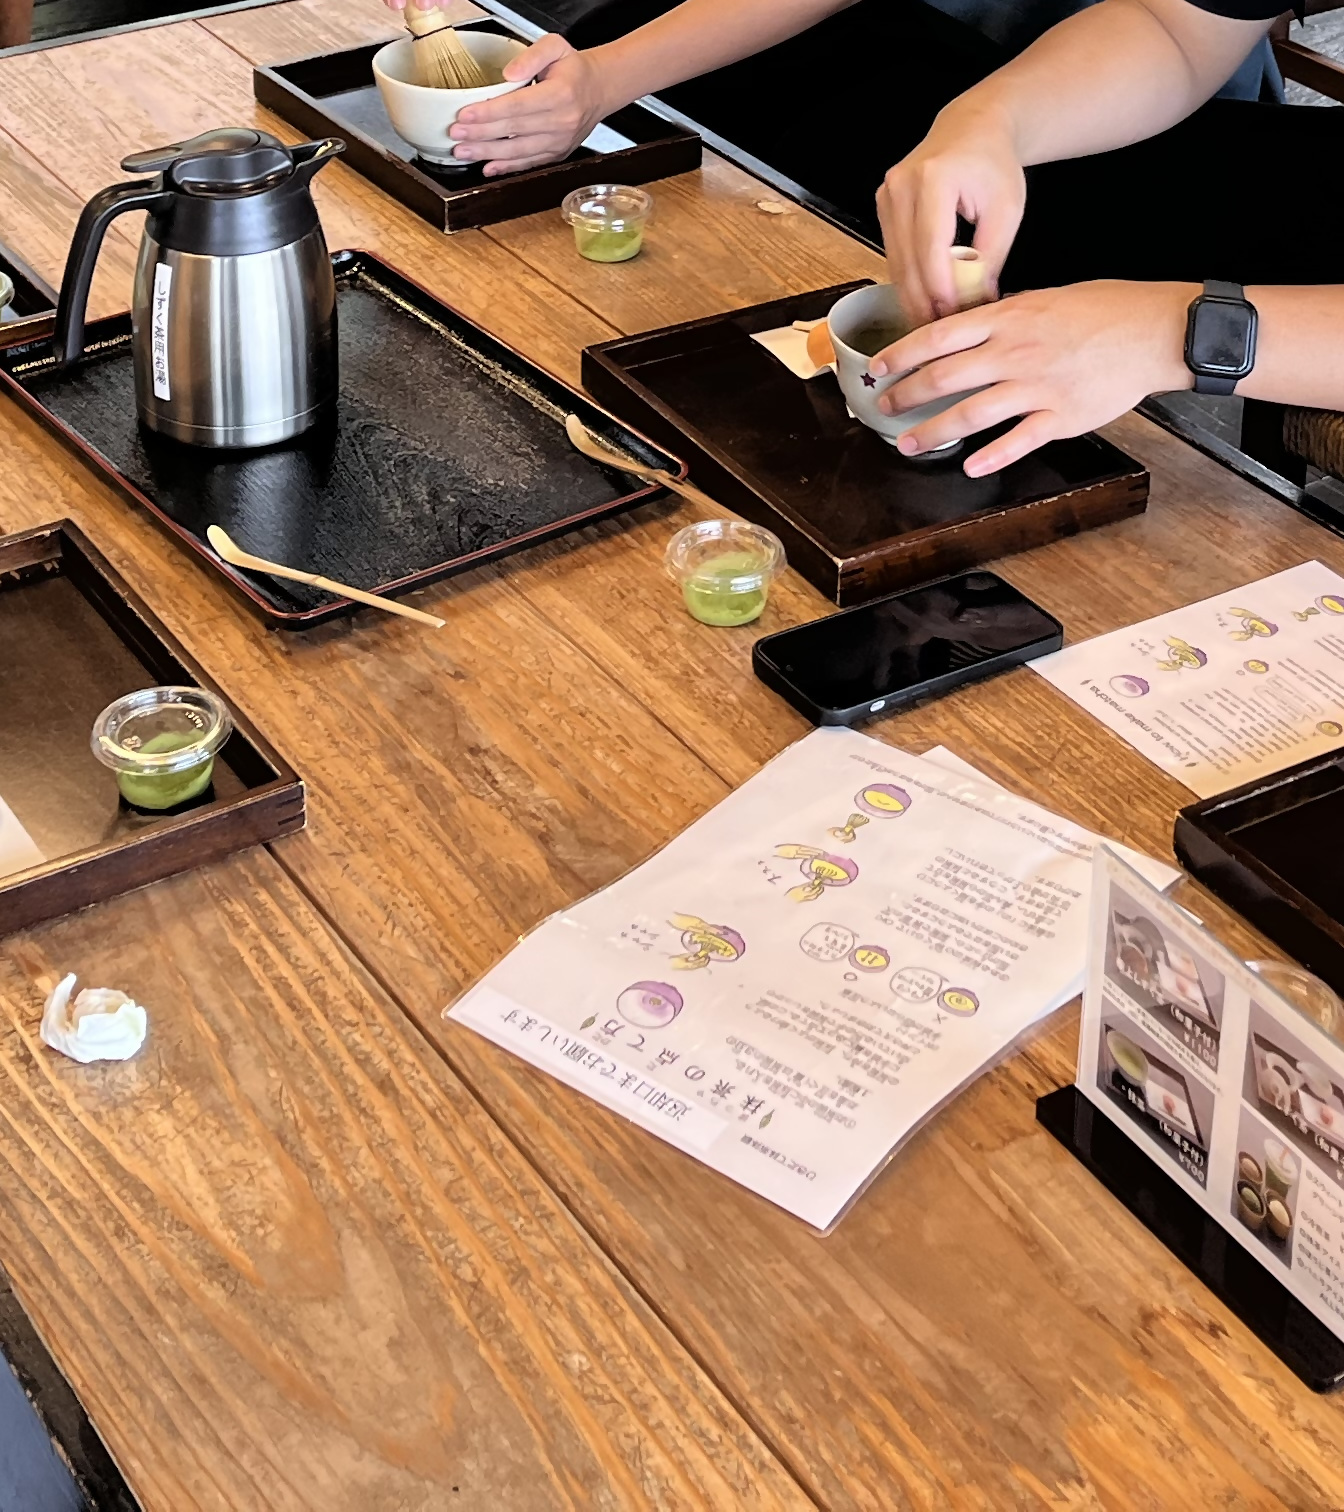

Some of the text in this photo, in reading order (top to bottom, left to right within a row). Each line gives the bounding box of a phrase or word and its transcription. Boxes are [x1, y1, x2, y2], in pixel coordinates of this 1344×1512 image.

[1085, 685, 1190, 761] How to make matcha
[493, 1003, 695, 1122] 返却口までお願いします
[595, 1016, 767, 1116] 抹茶の点て方
